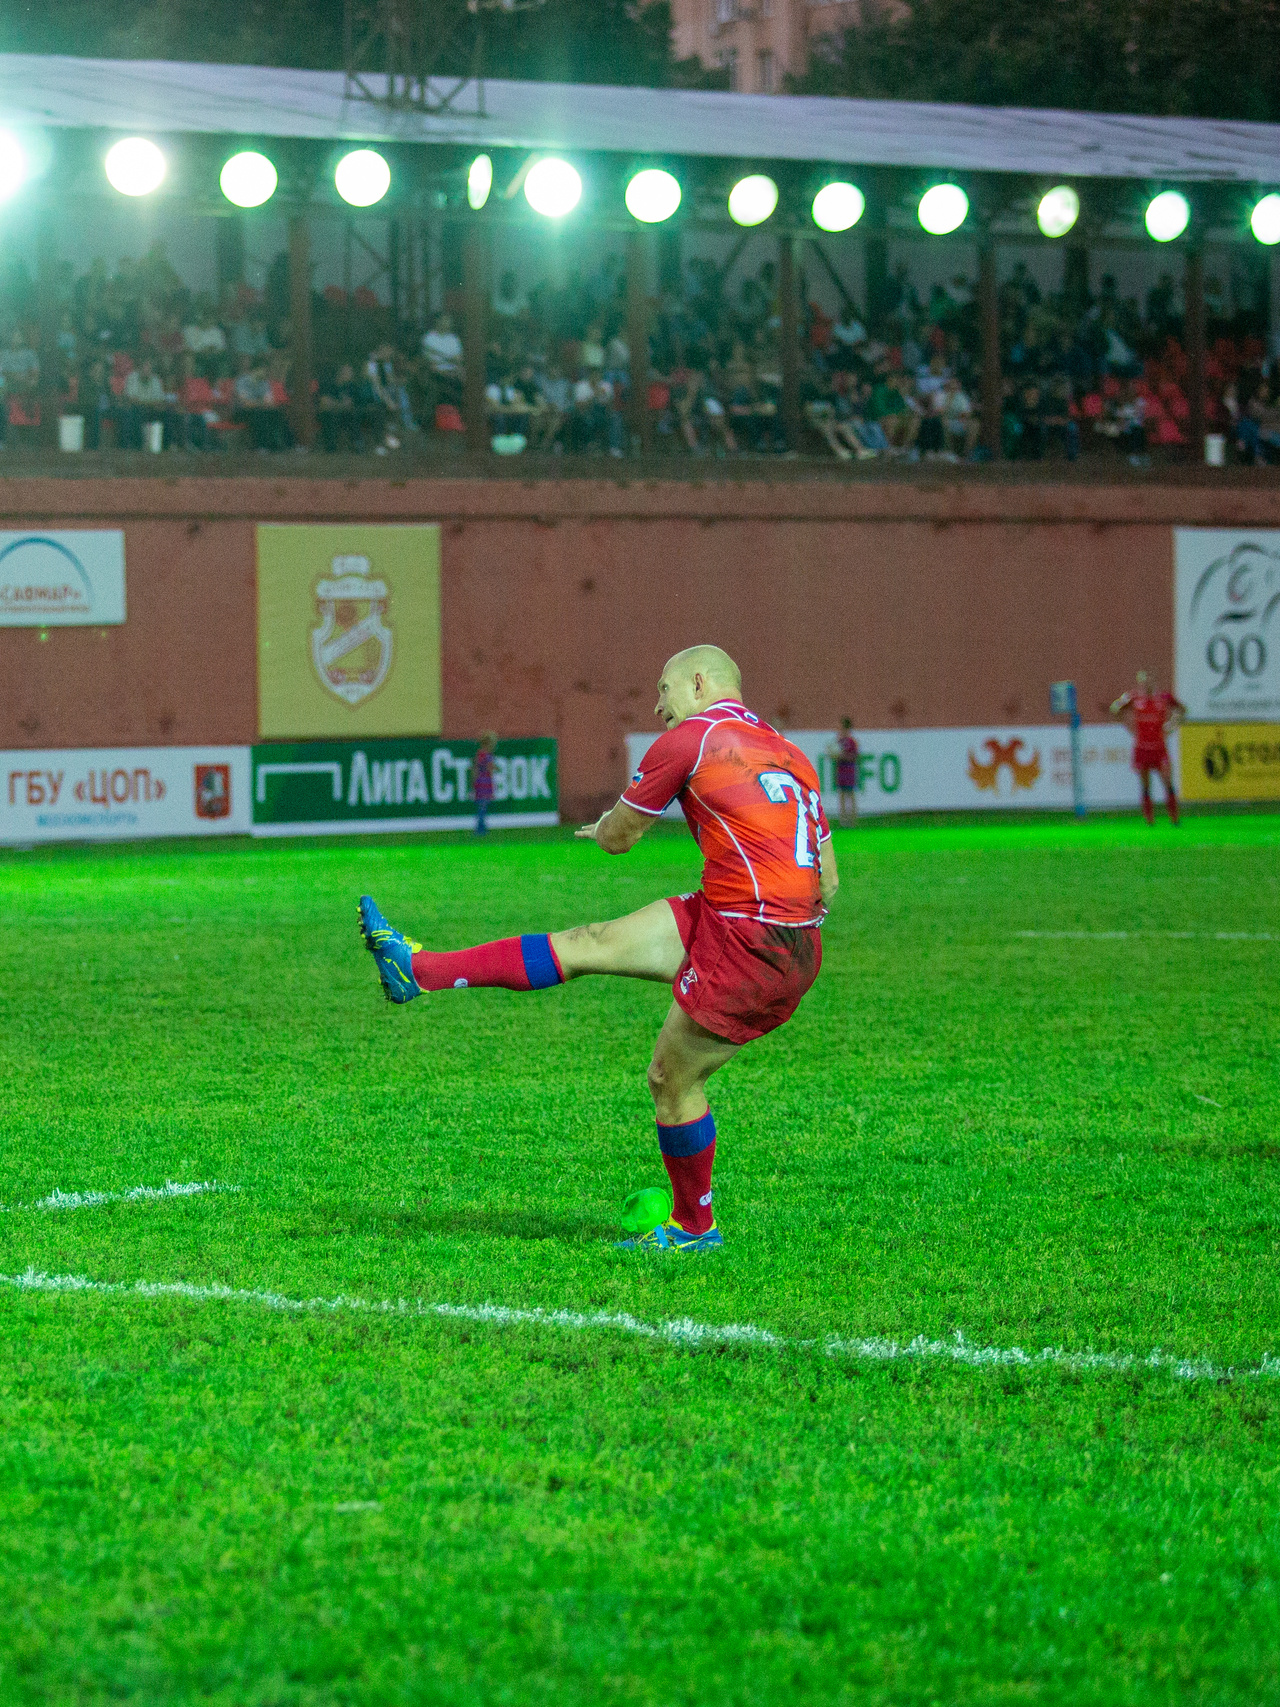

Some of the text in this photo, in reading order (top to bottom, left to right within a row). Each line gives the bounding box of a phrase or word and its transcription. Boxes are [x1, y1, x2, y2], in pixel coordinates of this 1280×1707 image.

[1206, 634, 1267, 696] 90
[8, 769, 166, 809] ГБУ «ЦОП»
[431, 749, 550, 803] СТВОК
